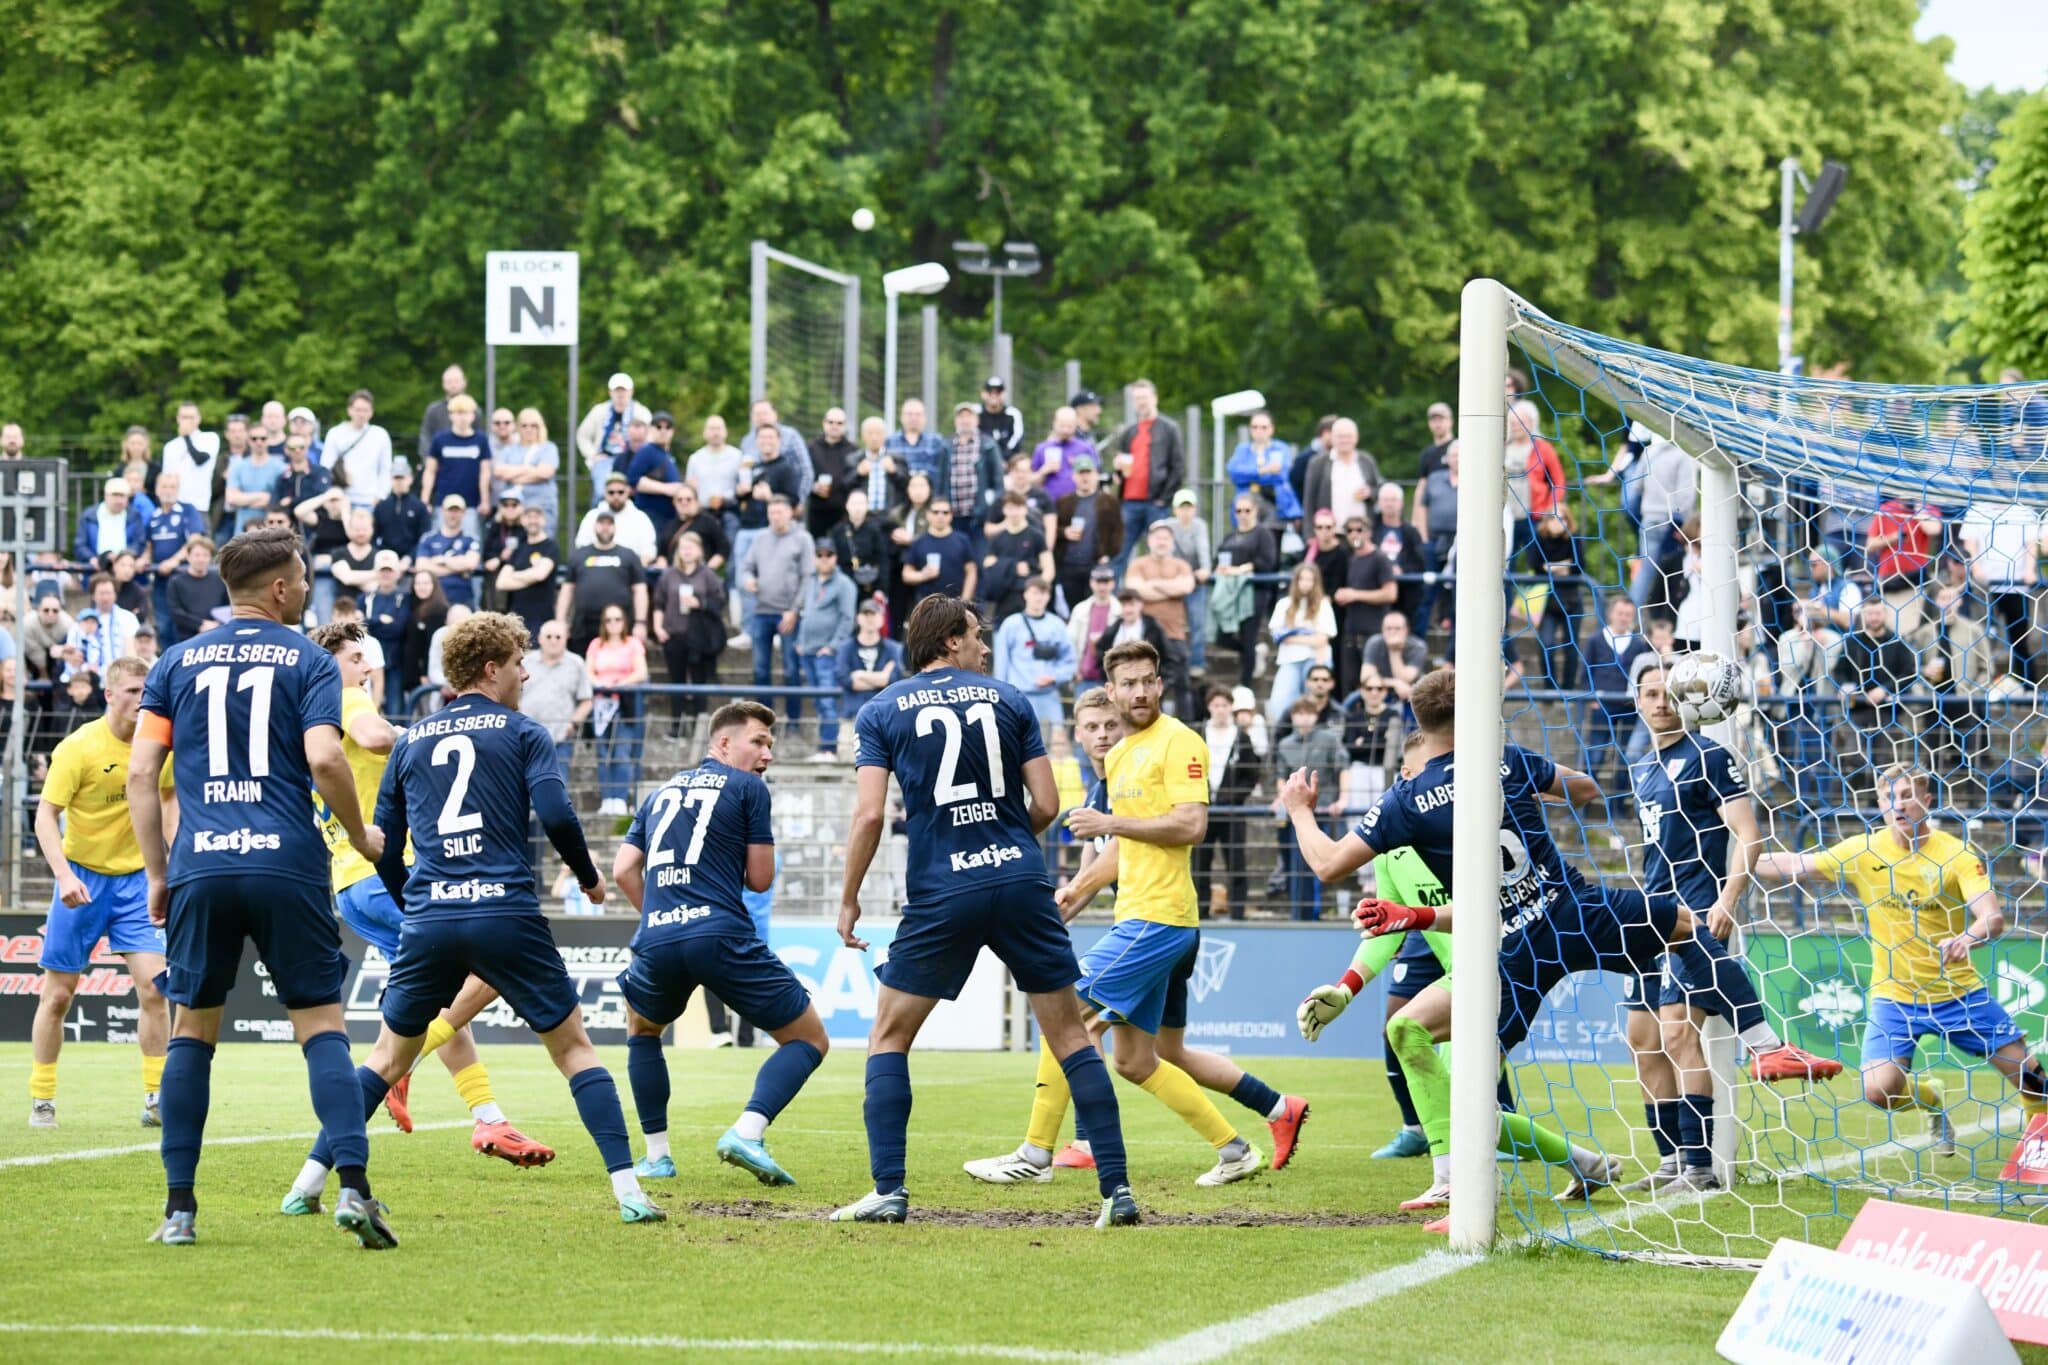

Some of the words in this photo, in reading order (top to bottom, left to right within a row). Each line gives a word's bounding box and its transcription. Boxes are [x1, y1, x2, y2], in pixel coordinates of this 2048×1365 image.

[500, 260, 563, 272] BLOCK
[182, 644, 300, 667] BABELSBERG
[896, 686, 1000, 712] BABELSBERG
[195, 666, 275, 777] 11
[407, 714, 507, 744] BABELSBERG
[915, 702, 1006, 807] 21
[203, 780, 262, 804] FRAHN
[431, 734, 483, 836] 2
[950, 802, 998, 827] ZEIGER
[193, 828, 280, 854] Katjes
[646, 787, 721, 872] 27
[443, 834, 483, 858] SILIC
[950, 843, 1023, 872] Katjes
[657, 866, 691, 888] BÜCH
[430, 878, 506, 903] Katjes
[648, 904, 711, 928] Katjes
[1184, 1021, 1287, 1038] AHNMEDIZIN
